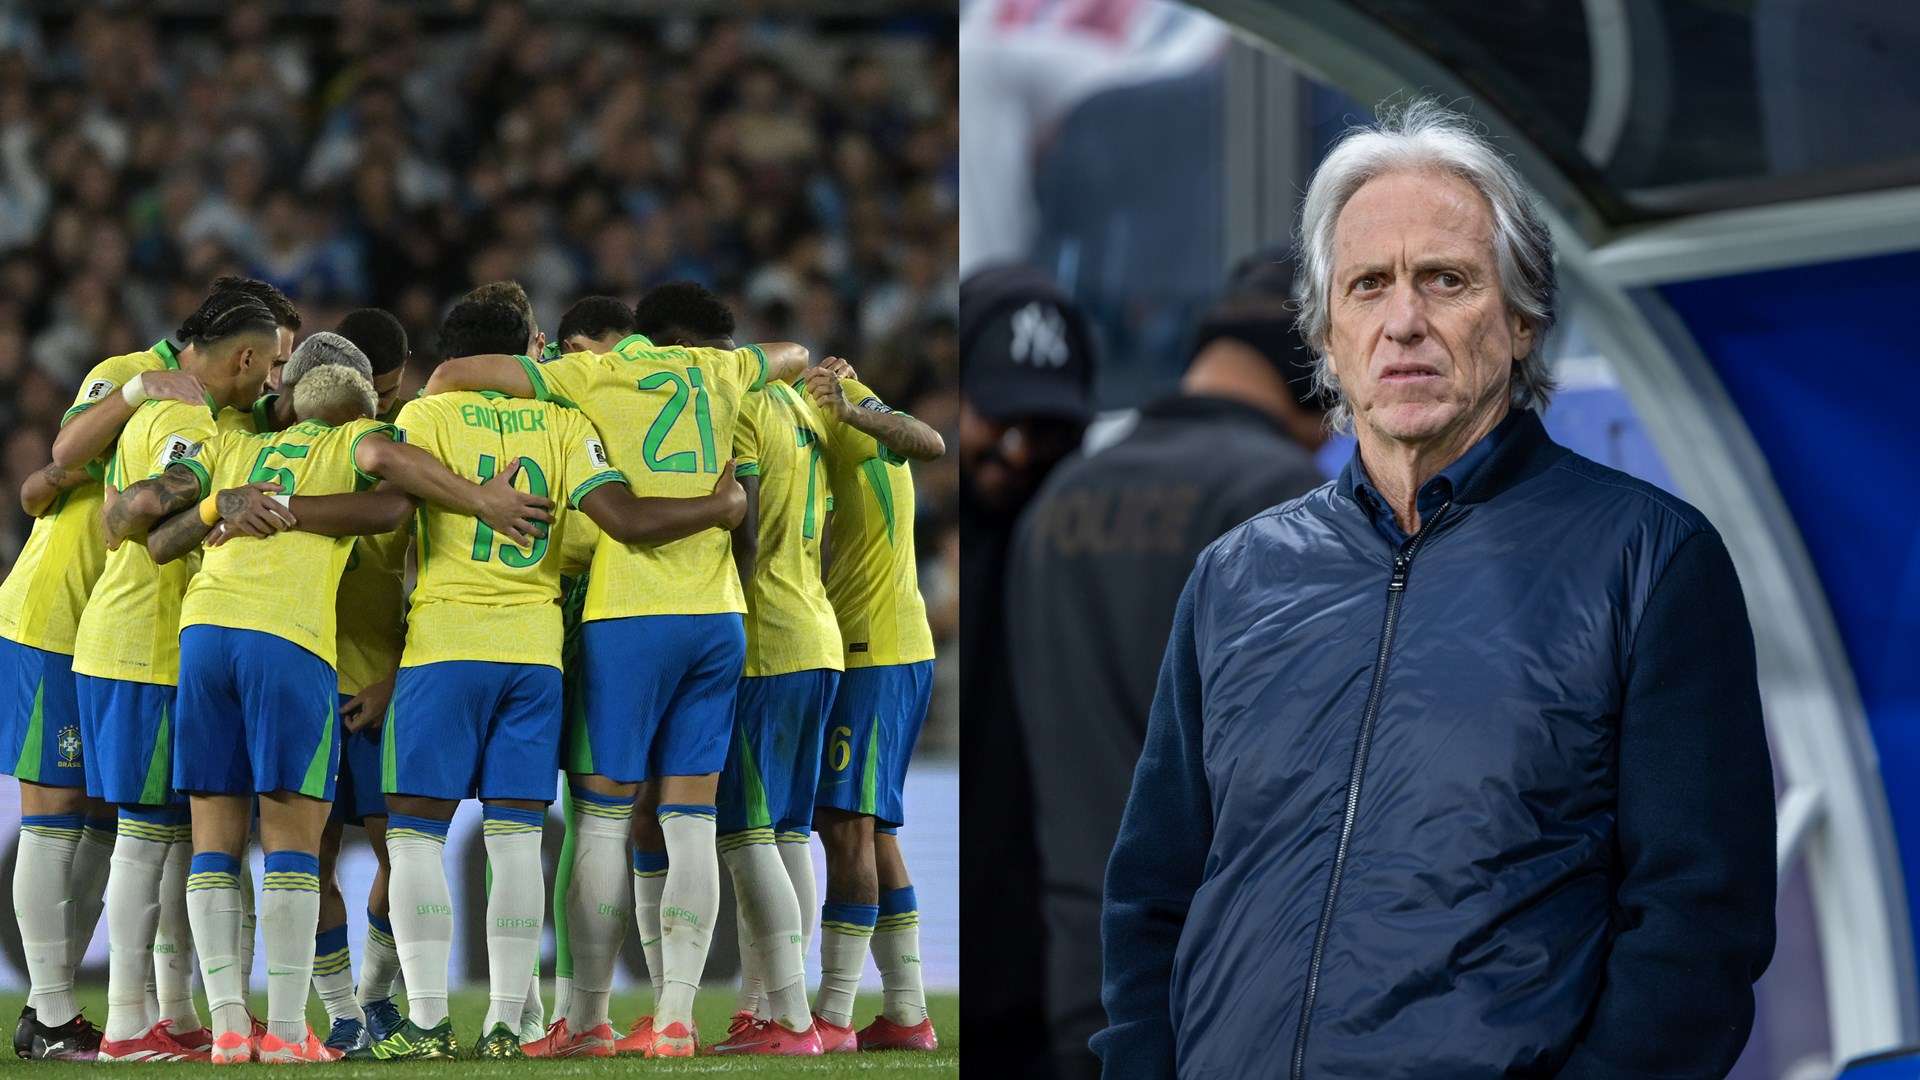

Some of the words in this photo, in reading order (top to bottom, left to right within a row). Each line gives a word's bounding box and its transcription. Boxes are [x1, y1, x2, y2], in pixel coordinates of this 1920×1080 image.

[461, 403, 546, 433] ENDRICK
[637, 366, 717, 473] 21
[248, 442, 309, 496] 5
[829, 726, 852, 772] 6
